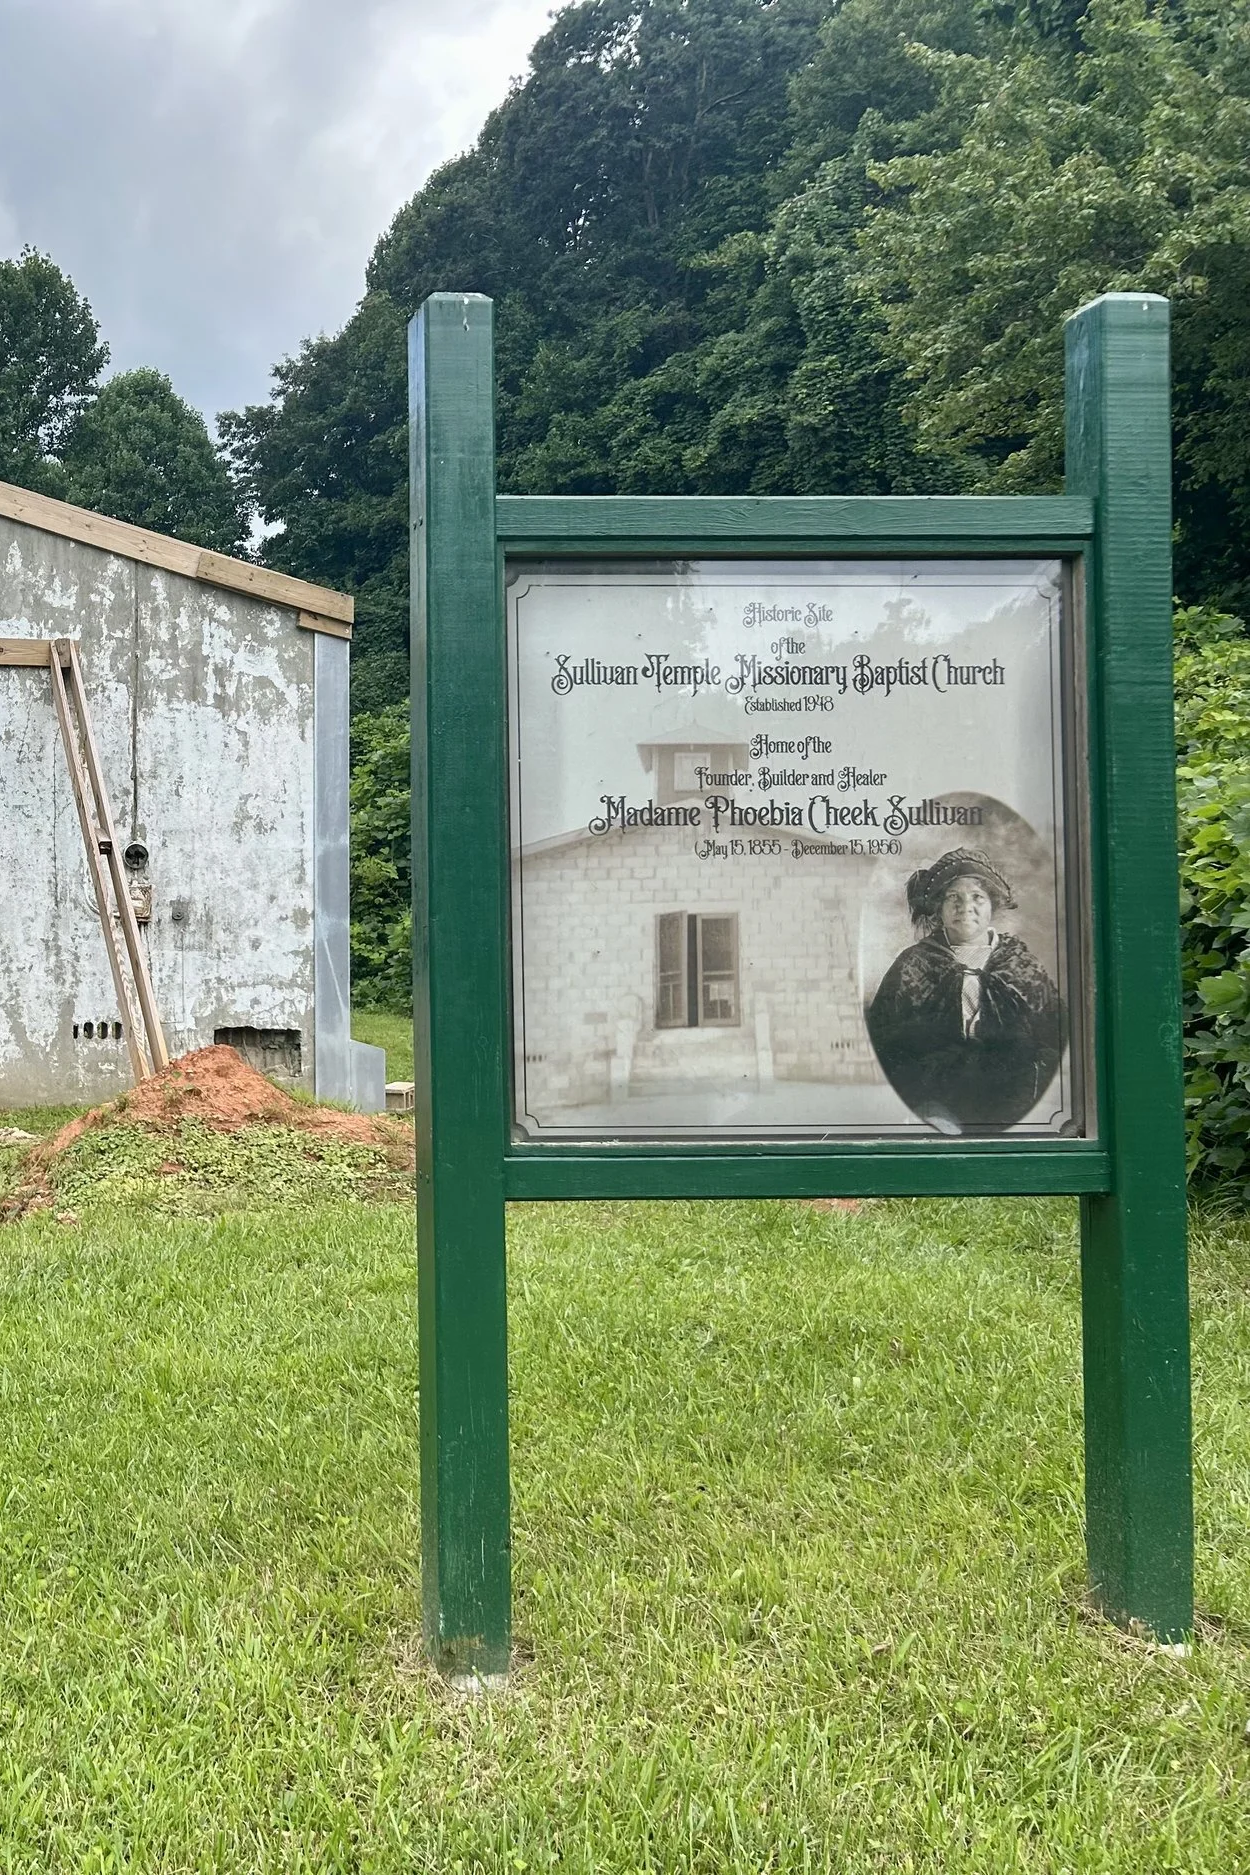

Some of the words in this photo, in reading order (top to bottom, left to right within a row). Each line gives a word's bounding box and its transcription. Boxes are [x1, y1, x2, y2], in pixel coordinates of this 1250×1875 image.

[742, 602, 802, 628] Historic
[804, 602, 833, 628] Site
[771, 637, 786, 661] of
[786, 637, 806, 654] the
[551, 654, 639, 695] Sullivan
[641, 653, 721, 697] Temple
[725, 652, 848, 695] Missionary
[852, 654, 929, 697] Baptist
[932, 654, 1006, 693] Church
[744, 696, 801, 715] Established
[804, 695, 834, 712] 1948
[749, 734, 795, 759] Home
[797, 736, 813, 760] of
[812, 736, 832, 753] the
[757, 766, 809, 791] Builder
[811, 769, 835, 786] and
[837, 766, 888, 792] Healer
[588, 795, 701, 836] Madame
[704, 795, 804, 834] Phoebia
[808, 795, 880, 834] Cheek
[883, 795, 984, 836] Sullivan
[694, 839, 728, 860] (May
[730, 839, 746, 857] 15,
[748, 839, 782, 856] 1855
[791, 840, 848, 859] December
[848, 839, 866, 857] 15,
[868, 839, 902, 856] 1956)
